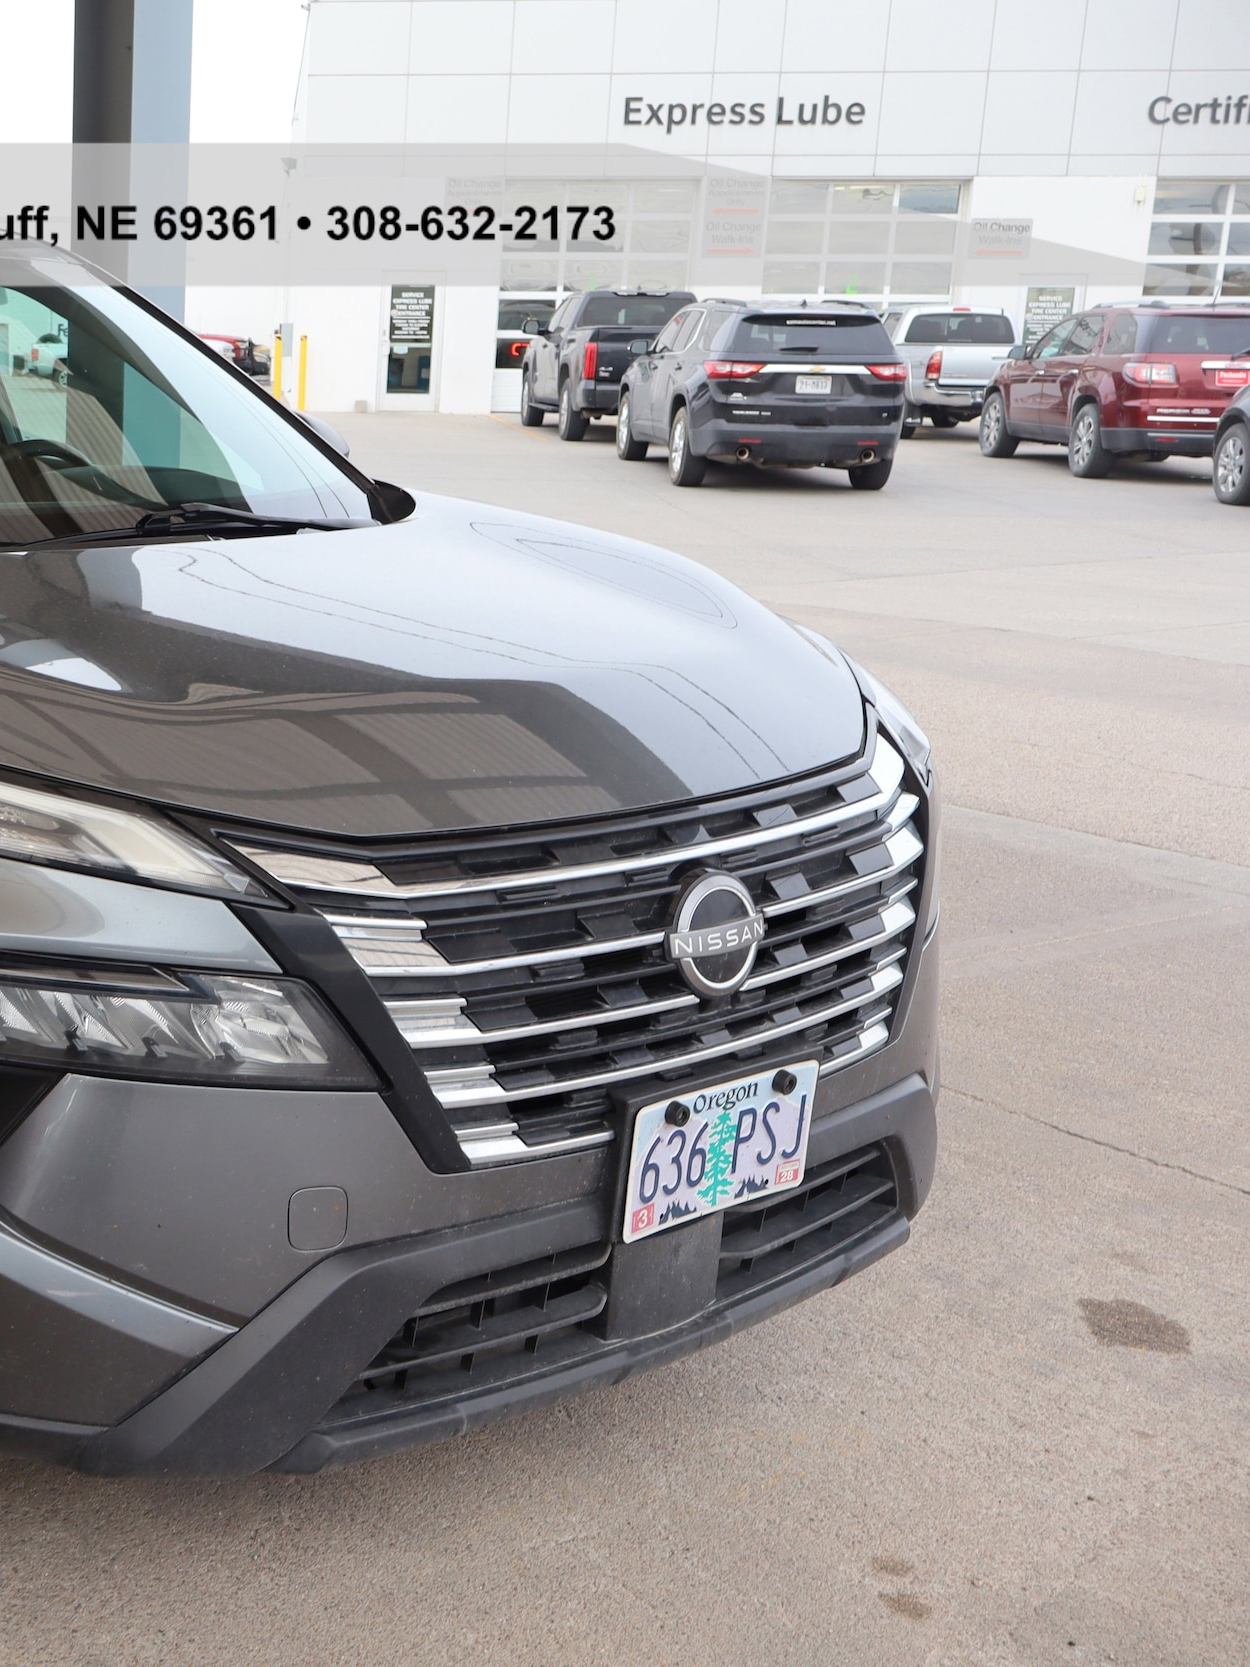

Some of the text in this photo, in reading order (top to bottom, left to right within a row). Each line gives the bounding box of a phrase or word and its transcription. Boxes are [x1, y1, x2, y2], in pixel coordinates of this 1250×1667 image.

[623, 94, 867, 135] Express Lube
[710, 178, 724, 188] Oil
[705, 222, 762, 234] Oil Change
[973, 222, 1031, 235] Oil Change
[674, 919, 764, 956] NISSAN
[692, 1081, 760, 1115] Oregon
[638, 1093, 808, 1205] 636 PSJ
[780, 1169, 795, 1183] 28
[637, 1208, 649, 1229] 3
